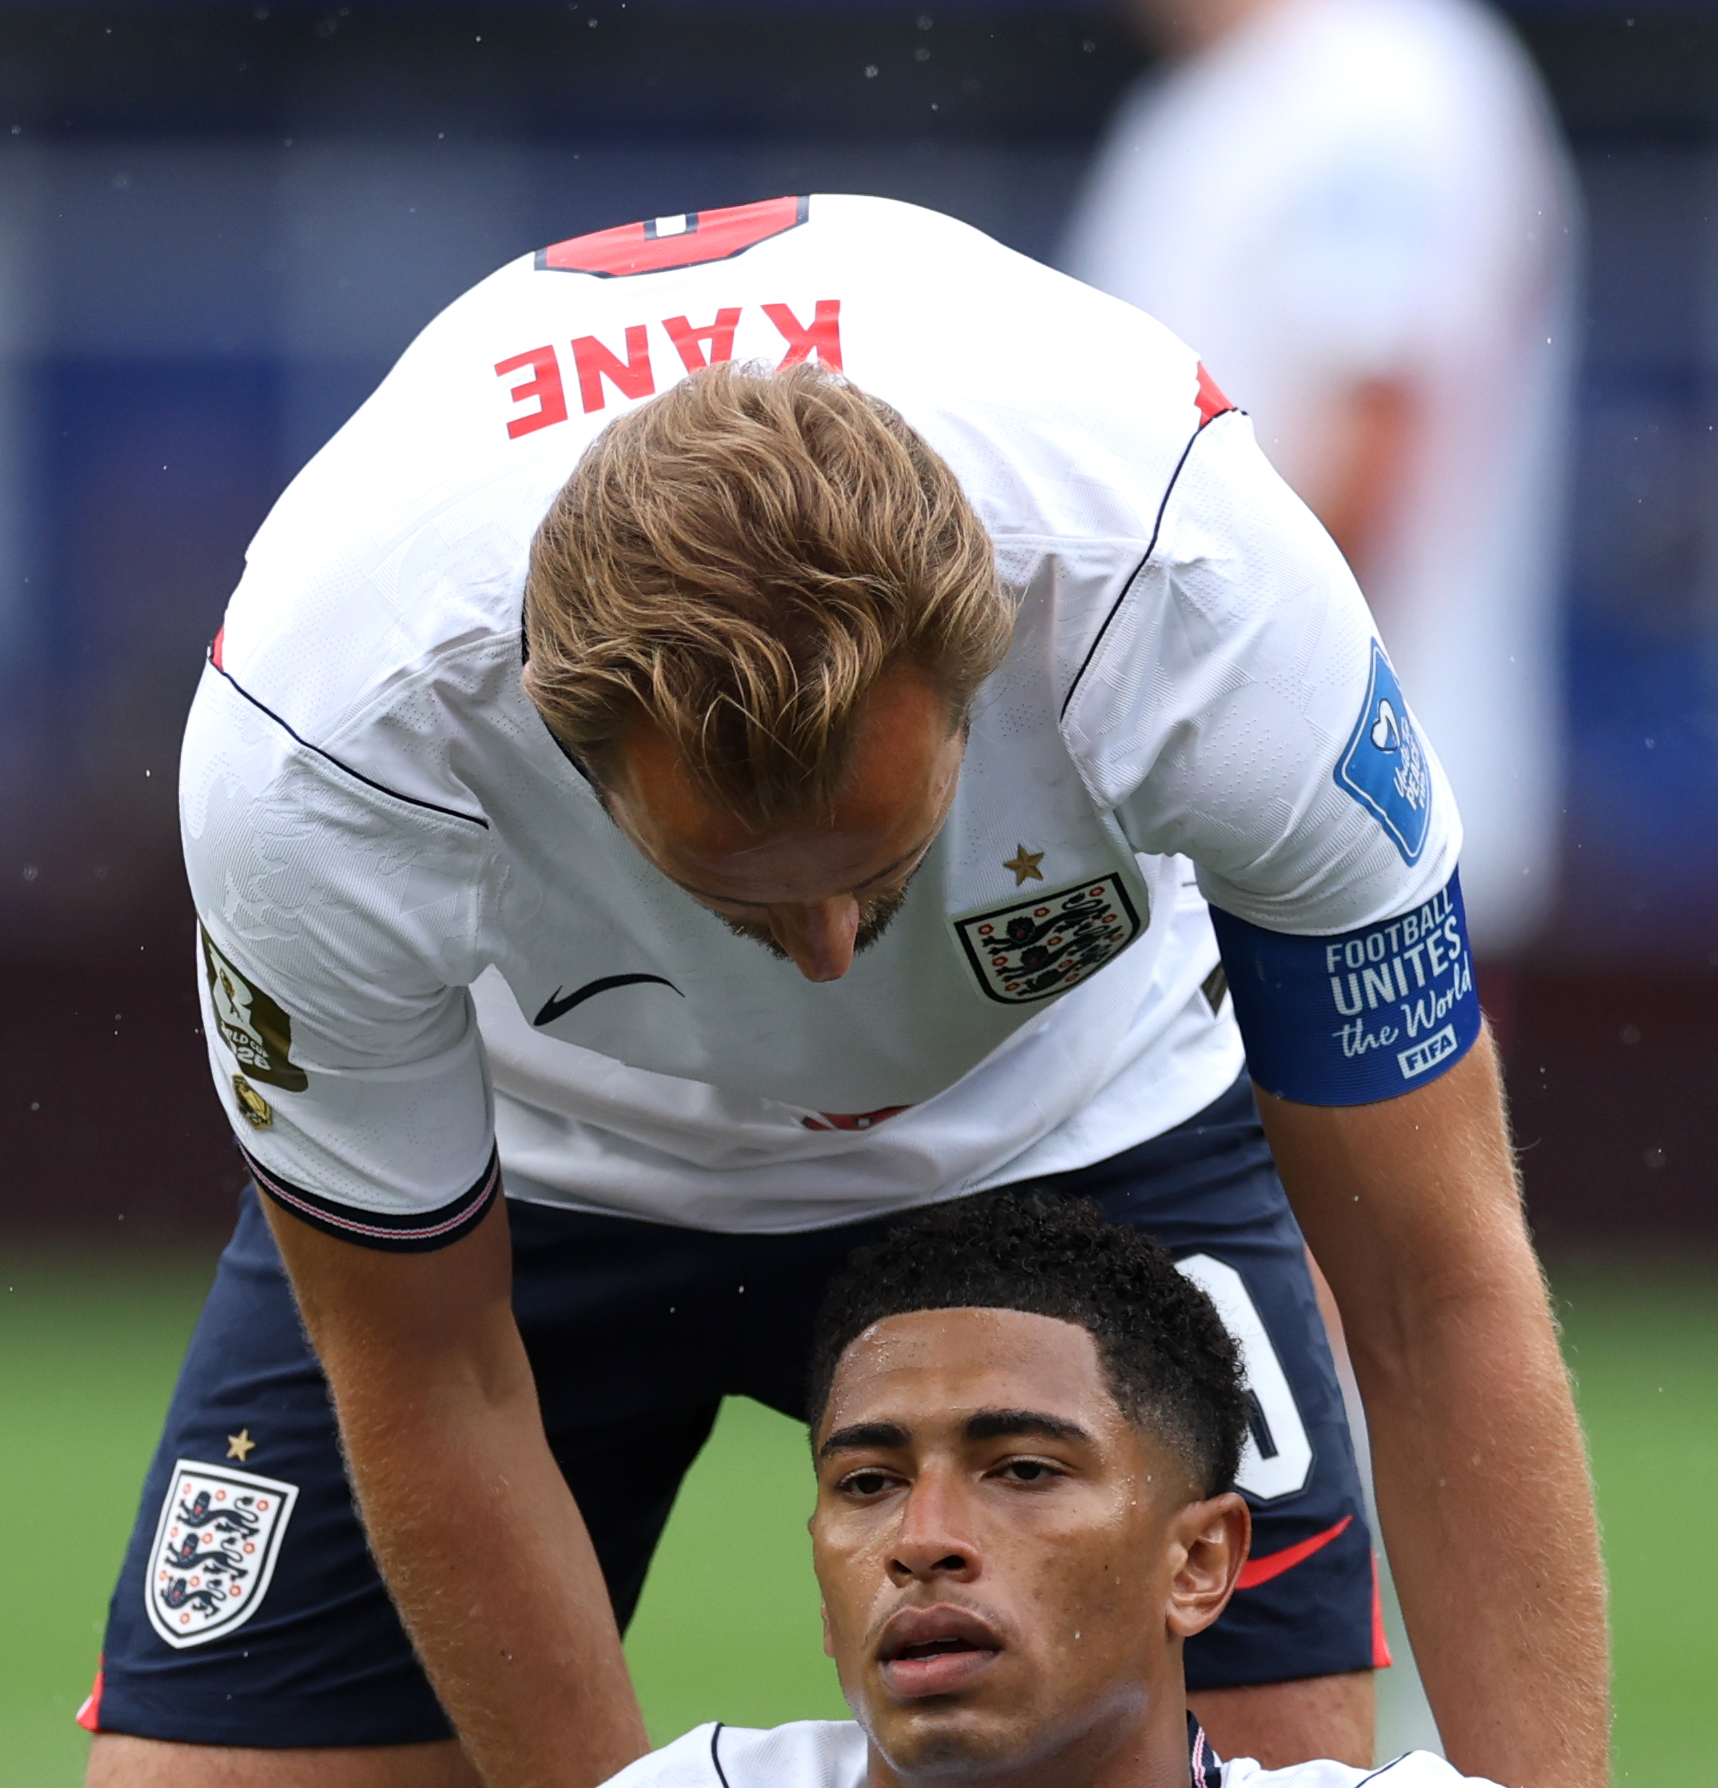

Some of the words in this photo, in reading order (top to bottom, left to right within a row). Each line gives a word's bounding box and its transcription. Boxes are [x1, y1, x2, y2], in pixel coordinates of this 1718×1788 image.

[493, 299, 844, 440] KANE
[1326, 886, 1453, 974] FOOTBALL
[1330, 915, 1461, 1016] UNITES
[1332, 1018, 1399, 1058] the
[1400, 950, 1472, 1038] World
[1404, 1033, 1454, 1073] FIFA
